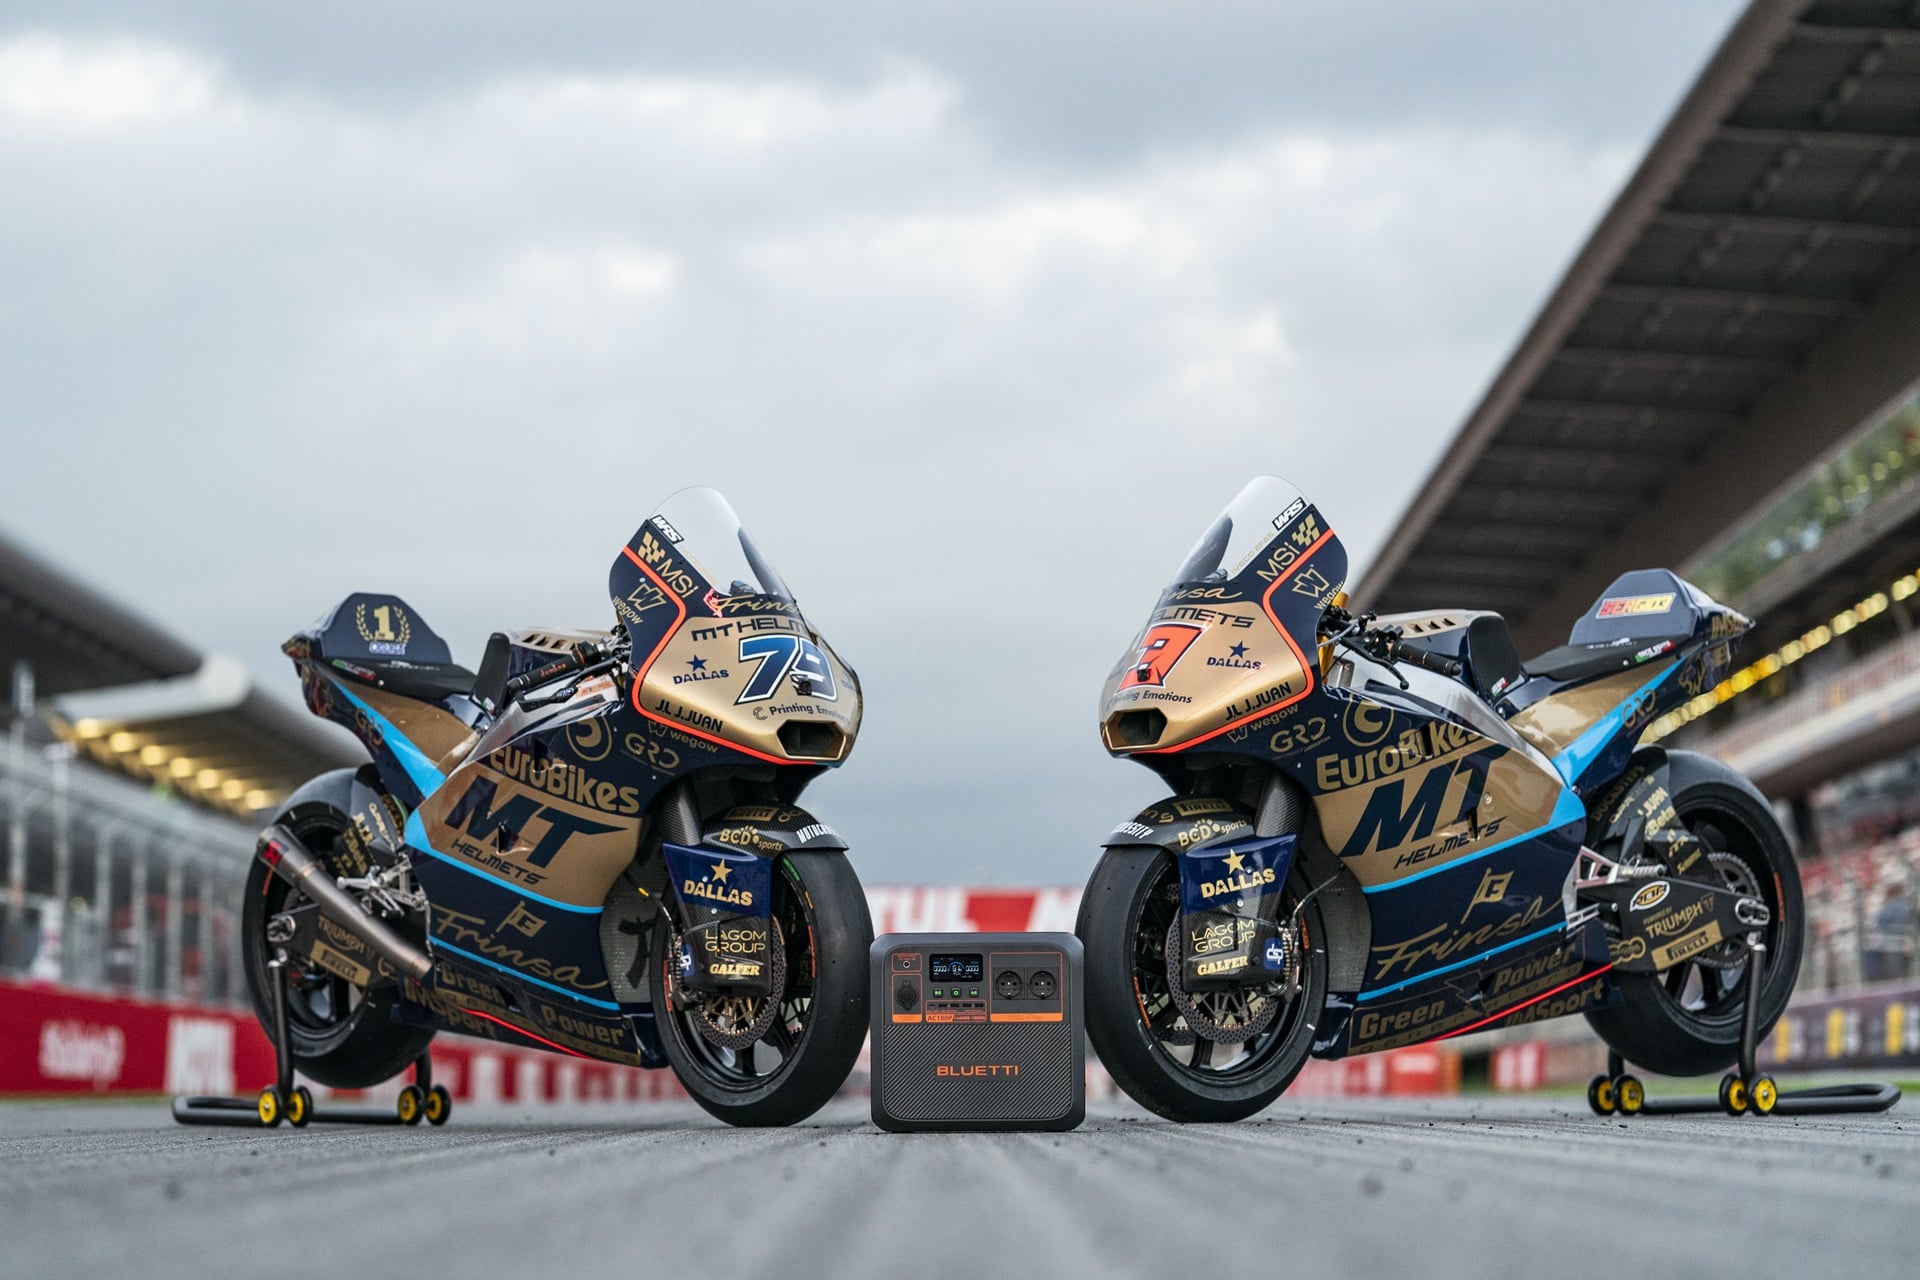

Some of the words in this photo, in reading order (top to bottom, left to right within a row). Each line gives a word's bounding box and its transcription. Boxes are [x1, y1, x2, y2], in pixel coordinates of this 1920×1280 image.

[1274, 498, 1304, 530] WRS
[652, 515, 683, 543] WRS
[373, 605, 395, 641] 1
[612, 596, 644, 625] wegow
[1151, 606, 1256, 629] ELMETS
[691, 621, 734, 642] MT
[736, 617, 804, 634] HELM
[734, 633, 838, 706] 79
[1206, 656, 1262, 670] DALLAS
[672, 669, 730, 685] DALLAS
[769, 703, 814, 716] Printing
[1142, 689, 1193, 704] Emotions
[1250, 704, 1299, 731] wegow
[669, 729, 719, 753] wegow
[443, 774, 630, 869] MT
[758, 840, 784, 851] sports
[450, 838, 548, 885] HELMETS
[683, 879, 753, 906] DALLAS
[1200, 868, 1276, 899] DALLAS
[1191, 919, 1255, 942] LAGOM
[1645, 901, 1704, 939] TRIUMPH
[431, 902, 609, 990] Frinsa
[705, 929, 767, 942] LAGOM
[705, 941, 766, 953] GROUP
[709, 963, 761, 976] GALFER
[1197, 955, 1249, 976] GALFER
[1491, 944, 1576, 994] Power
[540, 1004, 625, 1046] Power
[1358, 1000, 1446, 1040] Green
[936, 1065, 1020, 1077] BLUETTI
